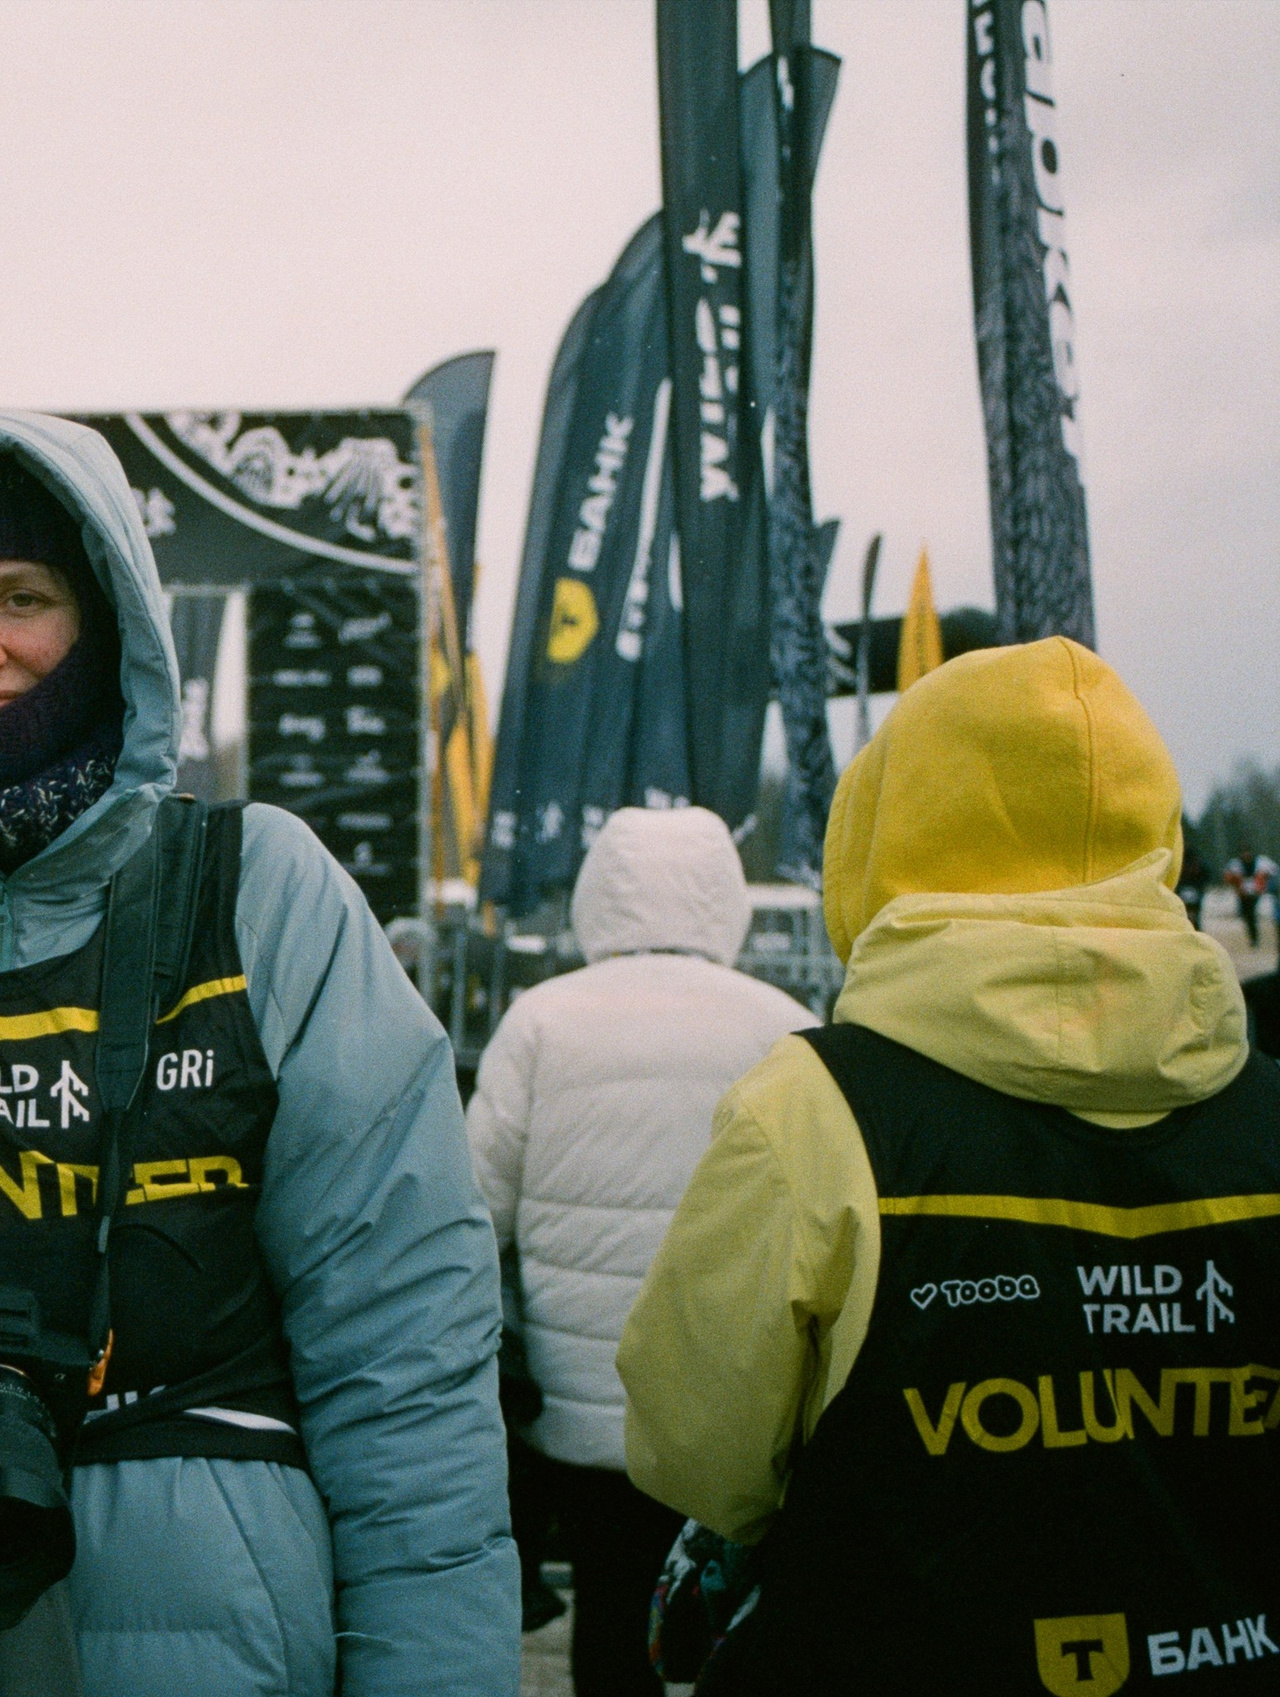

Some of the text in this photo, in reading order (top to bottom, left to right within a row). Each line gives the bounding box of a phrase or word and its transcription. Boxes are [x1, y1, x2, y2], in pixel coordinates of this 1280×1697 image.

[568, 412, 634, 571] БАНК
[156, 1049, 215, 1091] GRi
[1077, 1264, 1183, 1296] WILD
[1083, 1303, 1196, 1334] TRAIL
[1147, 1613, 1280, 1676] БАНК
